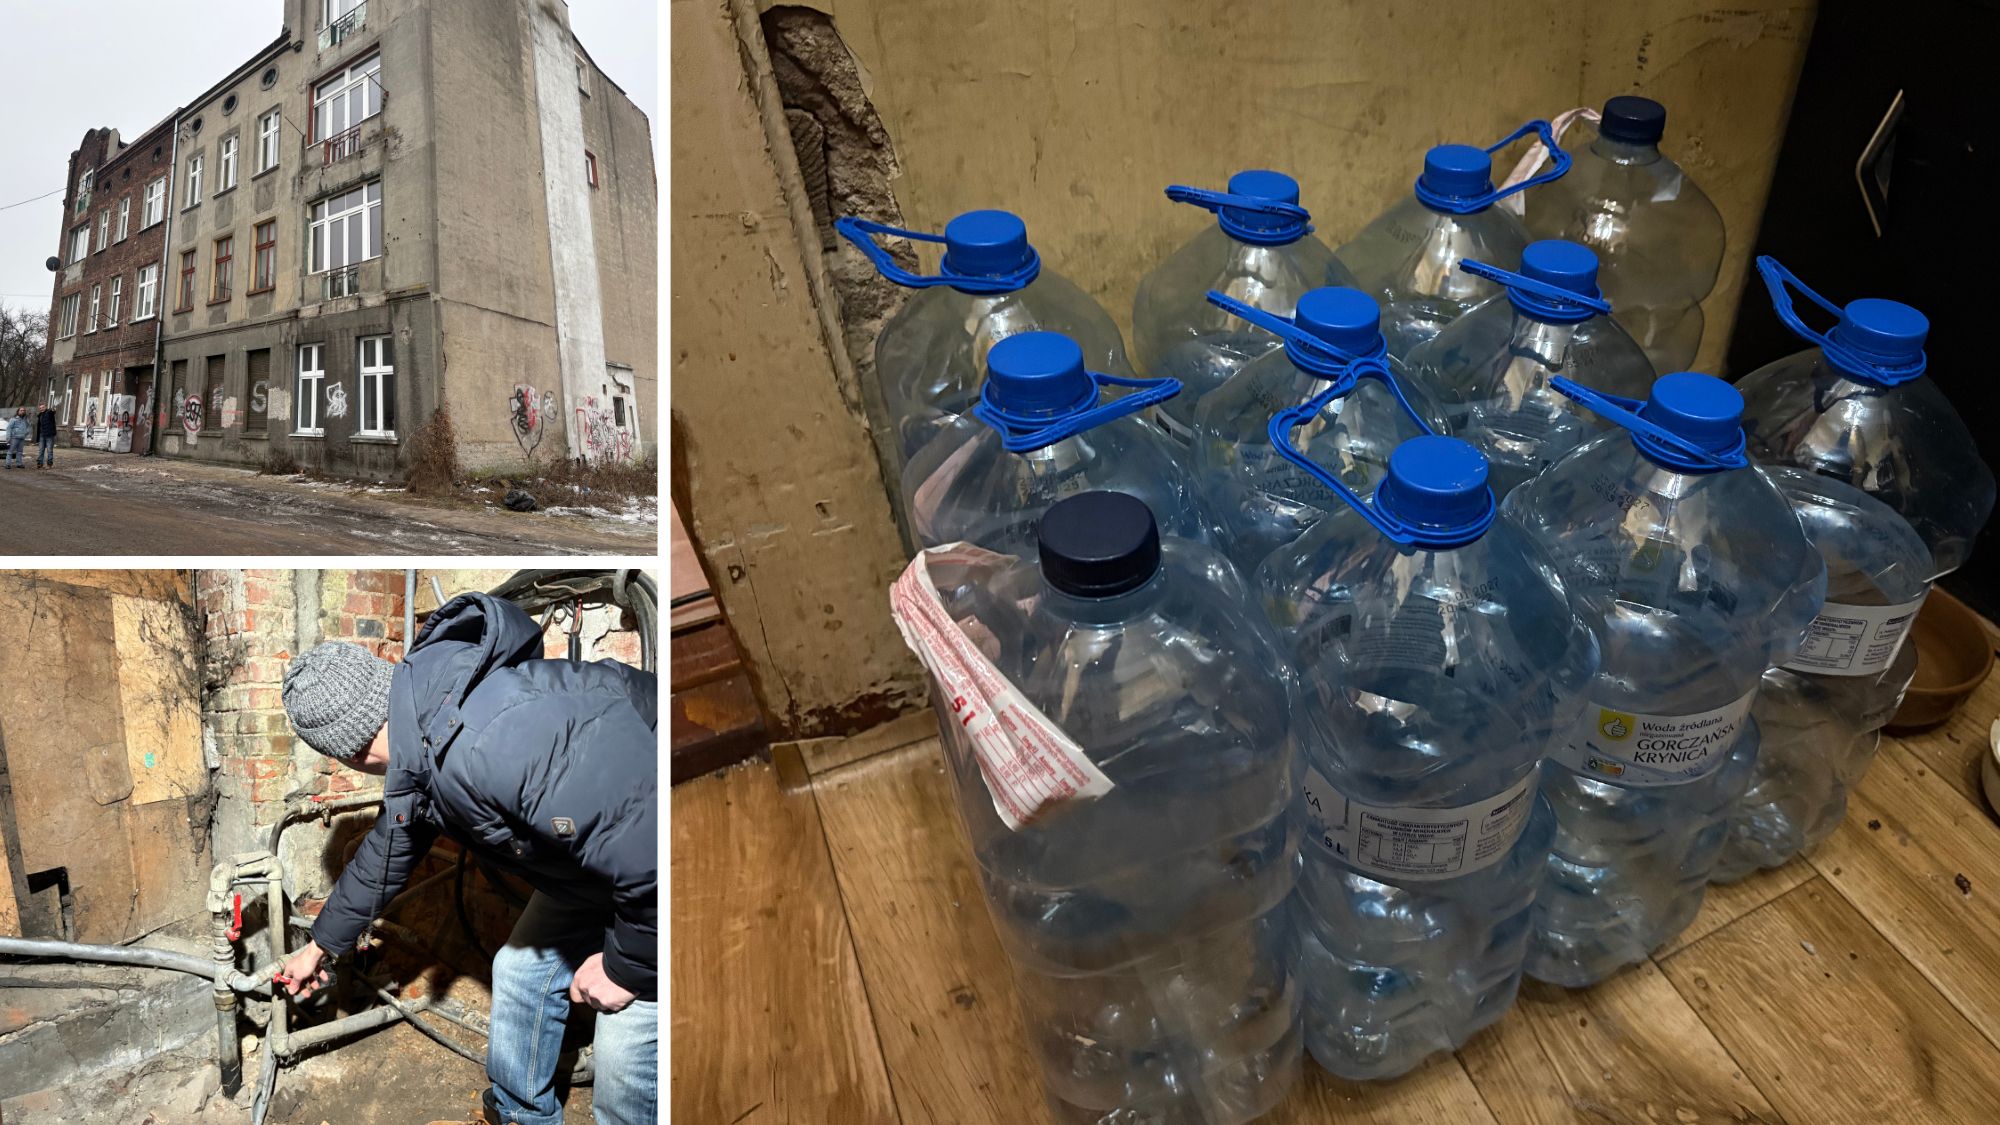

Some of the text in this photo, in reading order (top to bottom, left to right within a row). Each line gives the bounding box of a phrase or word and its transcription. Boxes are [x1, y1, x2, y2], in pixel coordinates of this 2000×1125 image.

[951, 696, 968, 713] 5
[1642, 716, 1723, 732] Woda źródlana
[1634, 747, 1708, 764] KRYNICA
[1325, 836, 1344, 855] 5 L
